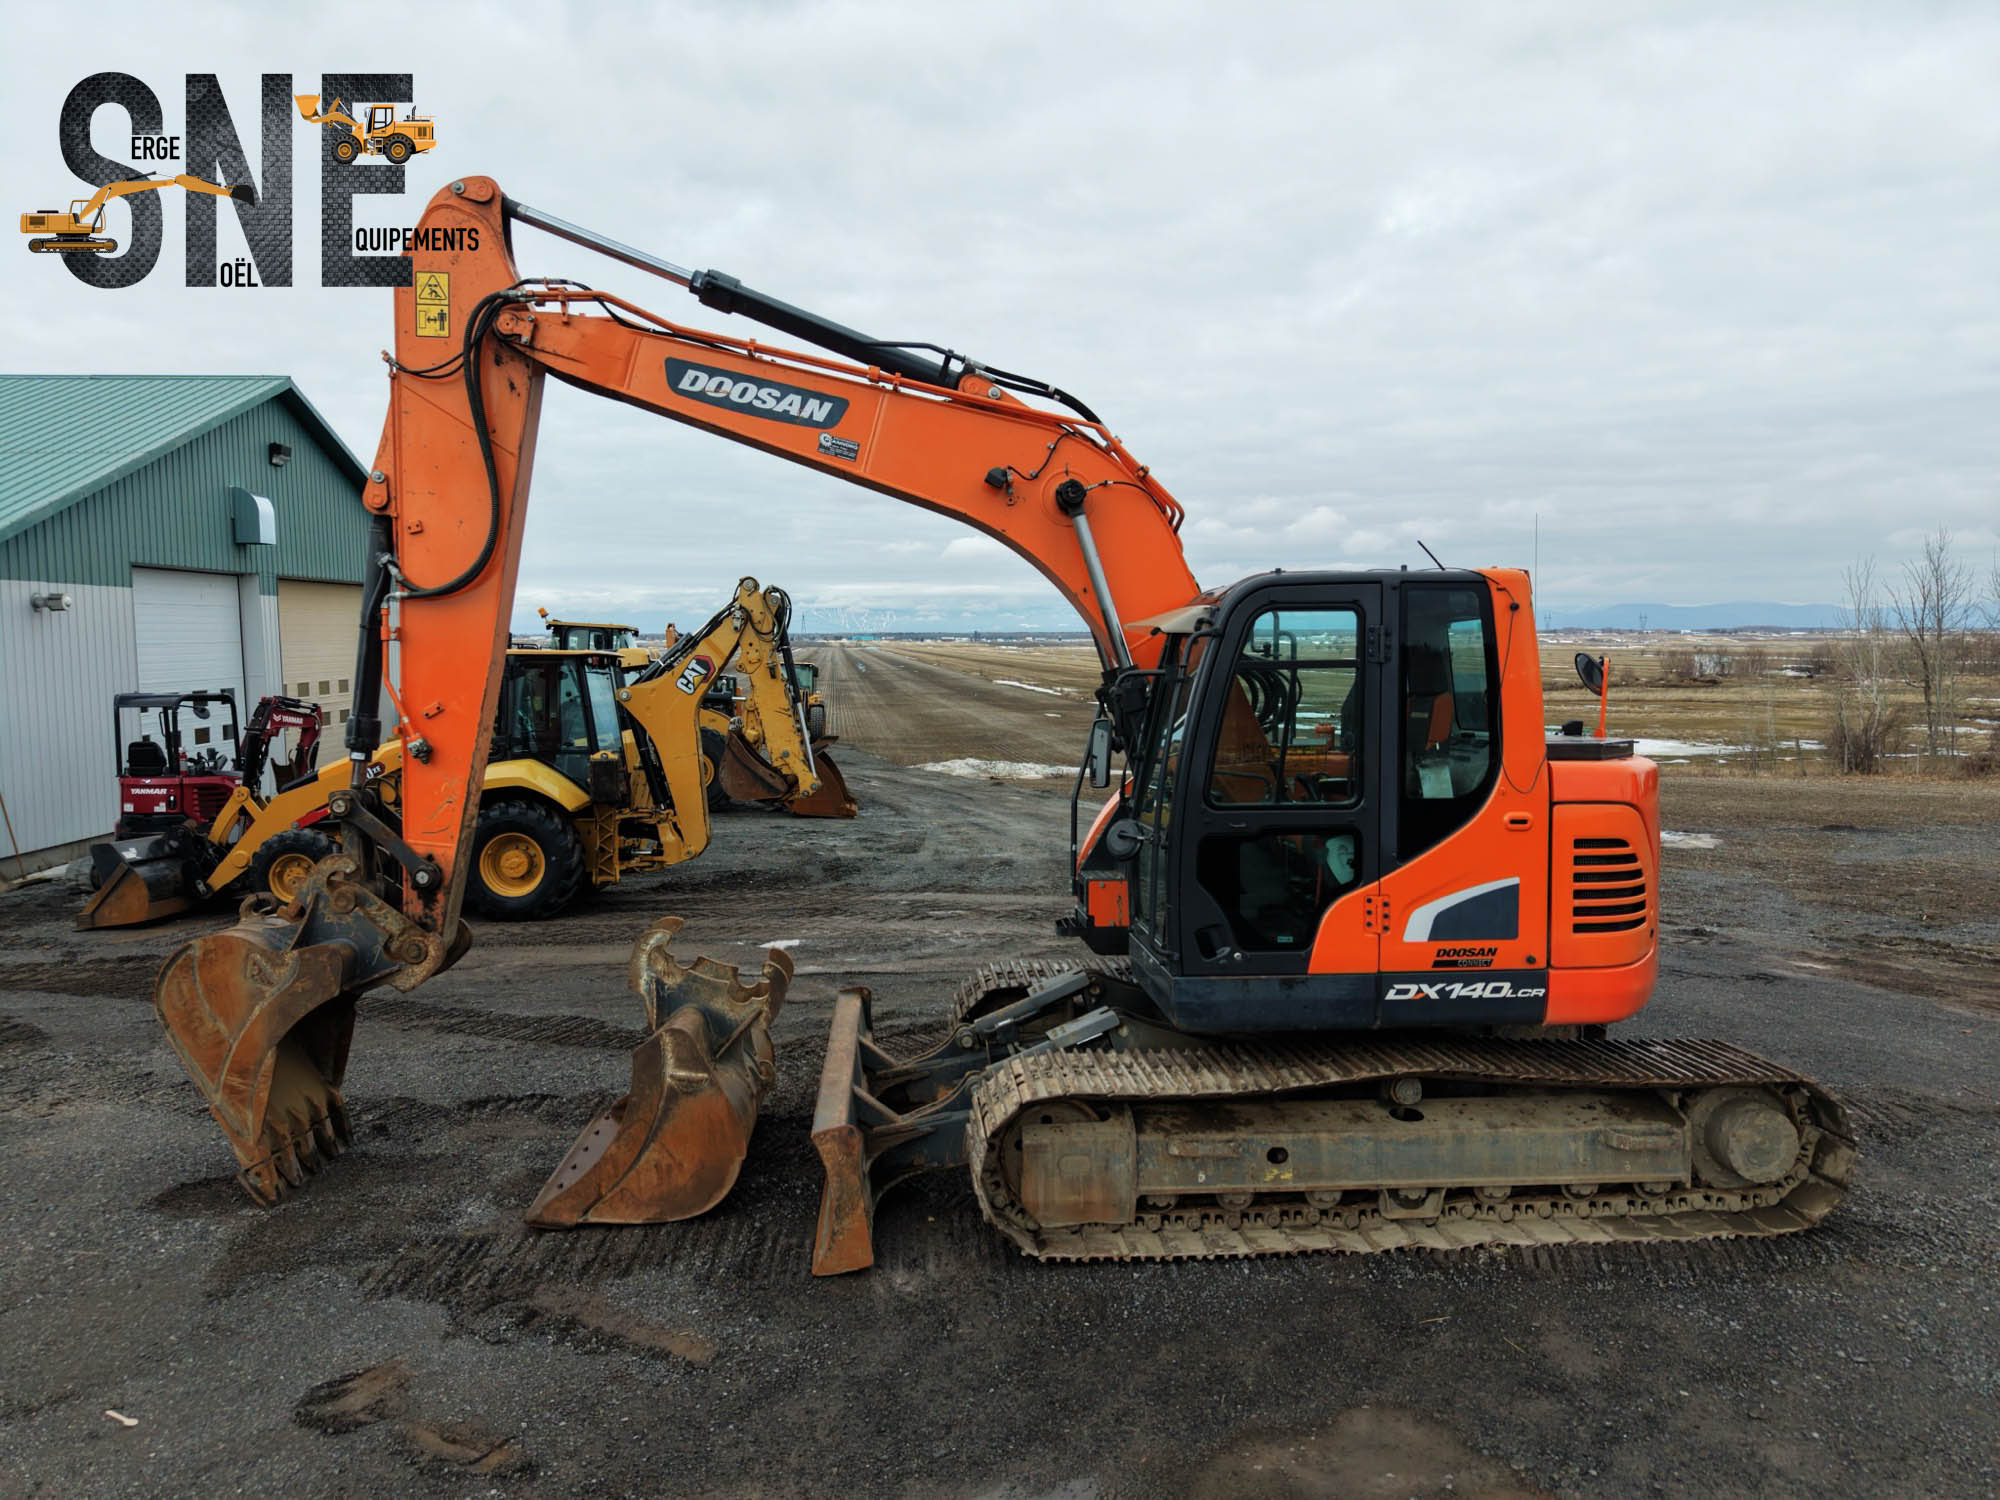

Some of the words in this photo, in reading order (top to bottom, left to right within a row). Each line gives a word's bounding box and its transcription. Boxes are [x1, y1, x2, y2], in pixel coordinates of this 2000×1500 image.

[678, 369, 833, 422] DOOSAN
[676, 659, 707, 694] CAT
[1436, 948, 1498, 958] DOOSAN
[1457, 959, 1492, 968] CONNECT
